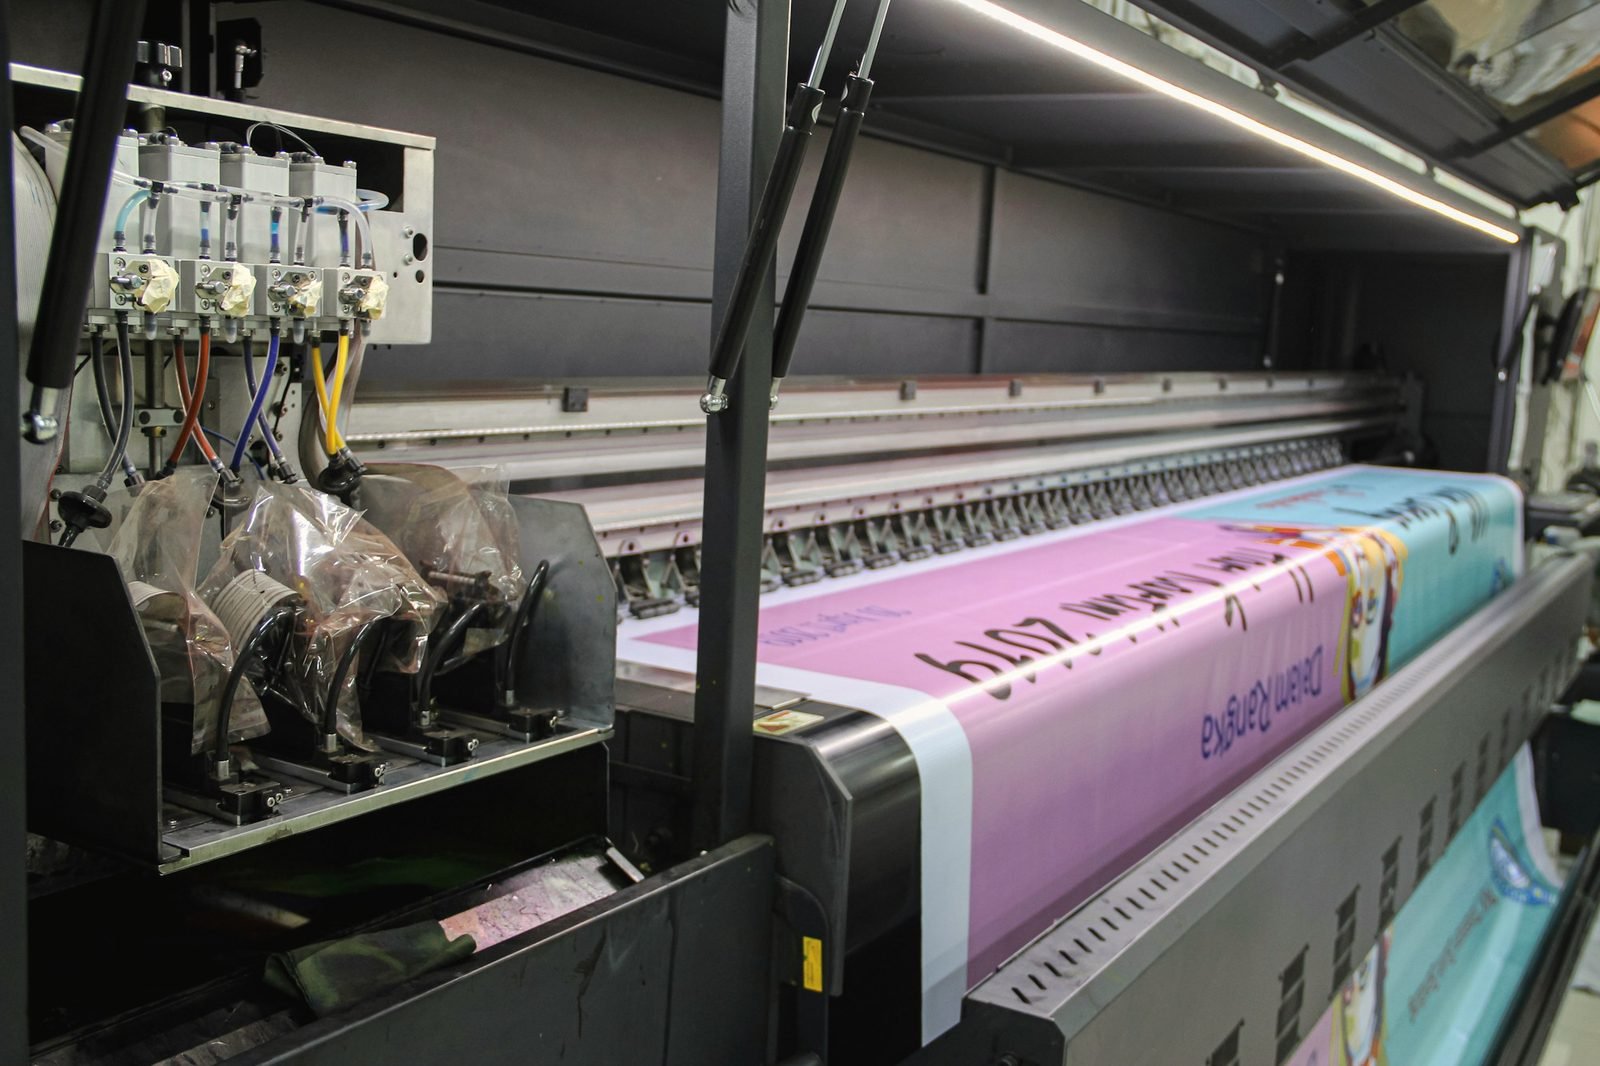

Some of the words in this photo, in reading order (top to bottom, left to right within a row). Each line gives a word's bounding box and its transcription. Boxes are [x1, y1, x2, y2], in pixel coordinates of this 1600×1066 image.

[914, 617, 1102, 700] 2019
[1275, 645, 1323, 712] Dalam
[1200, 680, 1271, 760] Rangka
